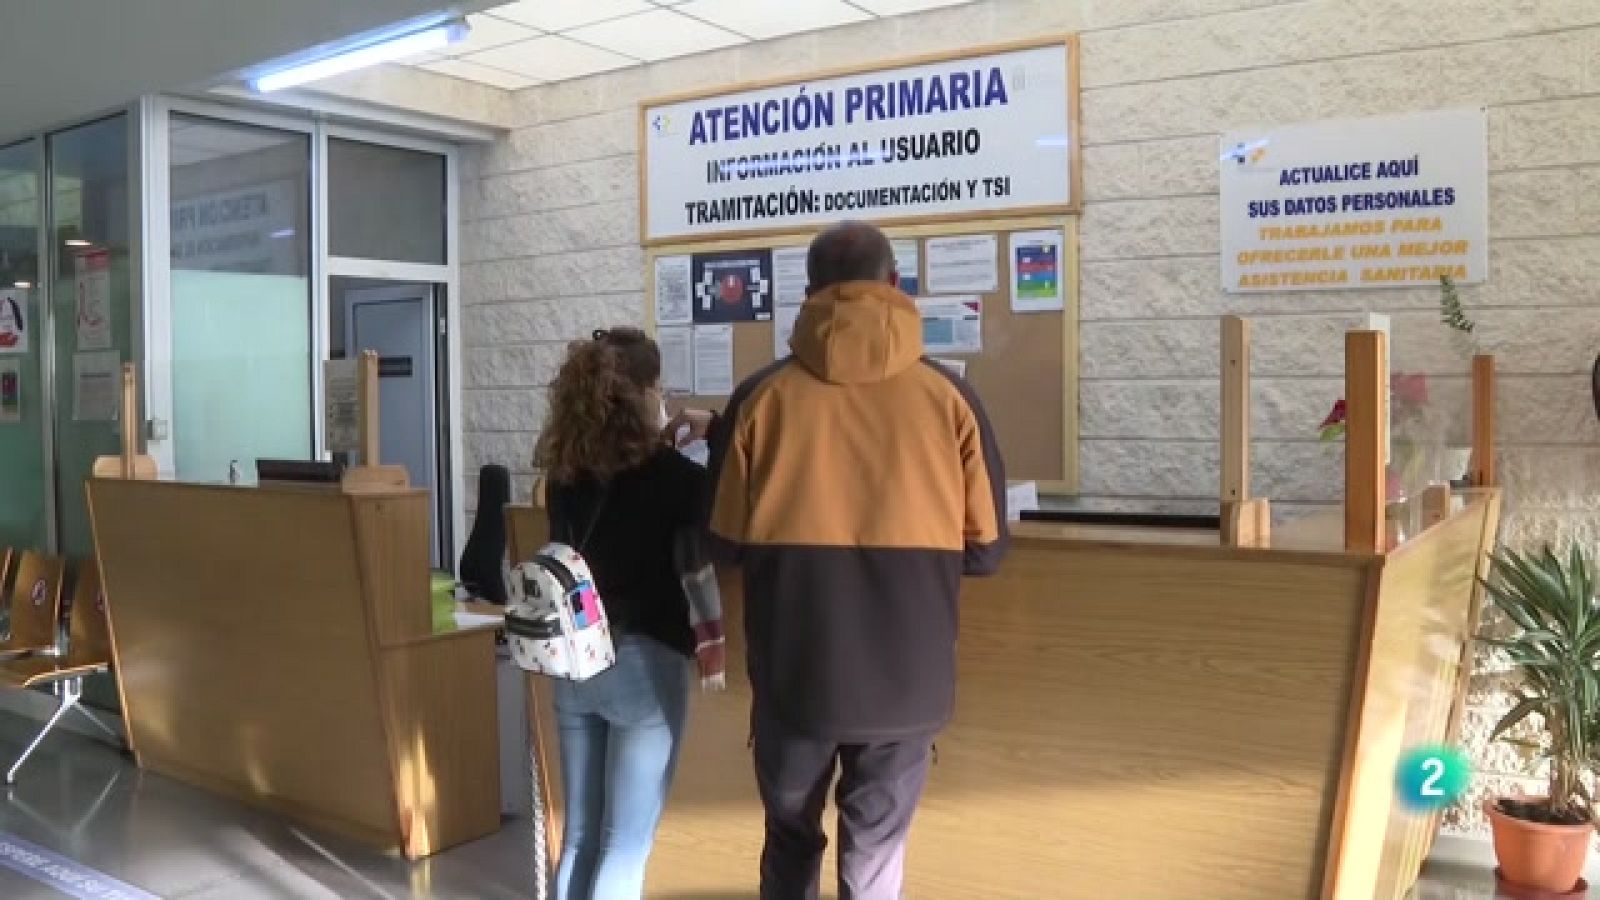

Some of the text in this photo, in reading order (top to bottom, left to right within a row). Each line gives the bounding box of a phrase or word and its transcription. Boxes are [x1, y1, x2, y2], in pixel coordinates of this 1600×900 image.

[689, 67, 1008, 145] ATENCIÓN PRIMARIA
[706, 127, 981, 183] INFORMACIÓN AL USUARIO
[1279, 154, 1419, 186] ACTUALICE AQUÍ
[685, 176, 1011, 225] TRAMITACIÓN: DOCUMENTACIÓN Y TSI
[1248, 187, 1456, 218] SUS DATOS PERSONALES
[1260, 217, 1443, 240] TRABAJAMOS PARA
[1237, 240, 1470, 265] OFRECERLE UNA MEJOR
[1239, 264, 1468, 288] ASISTENCIA SANITARIA
